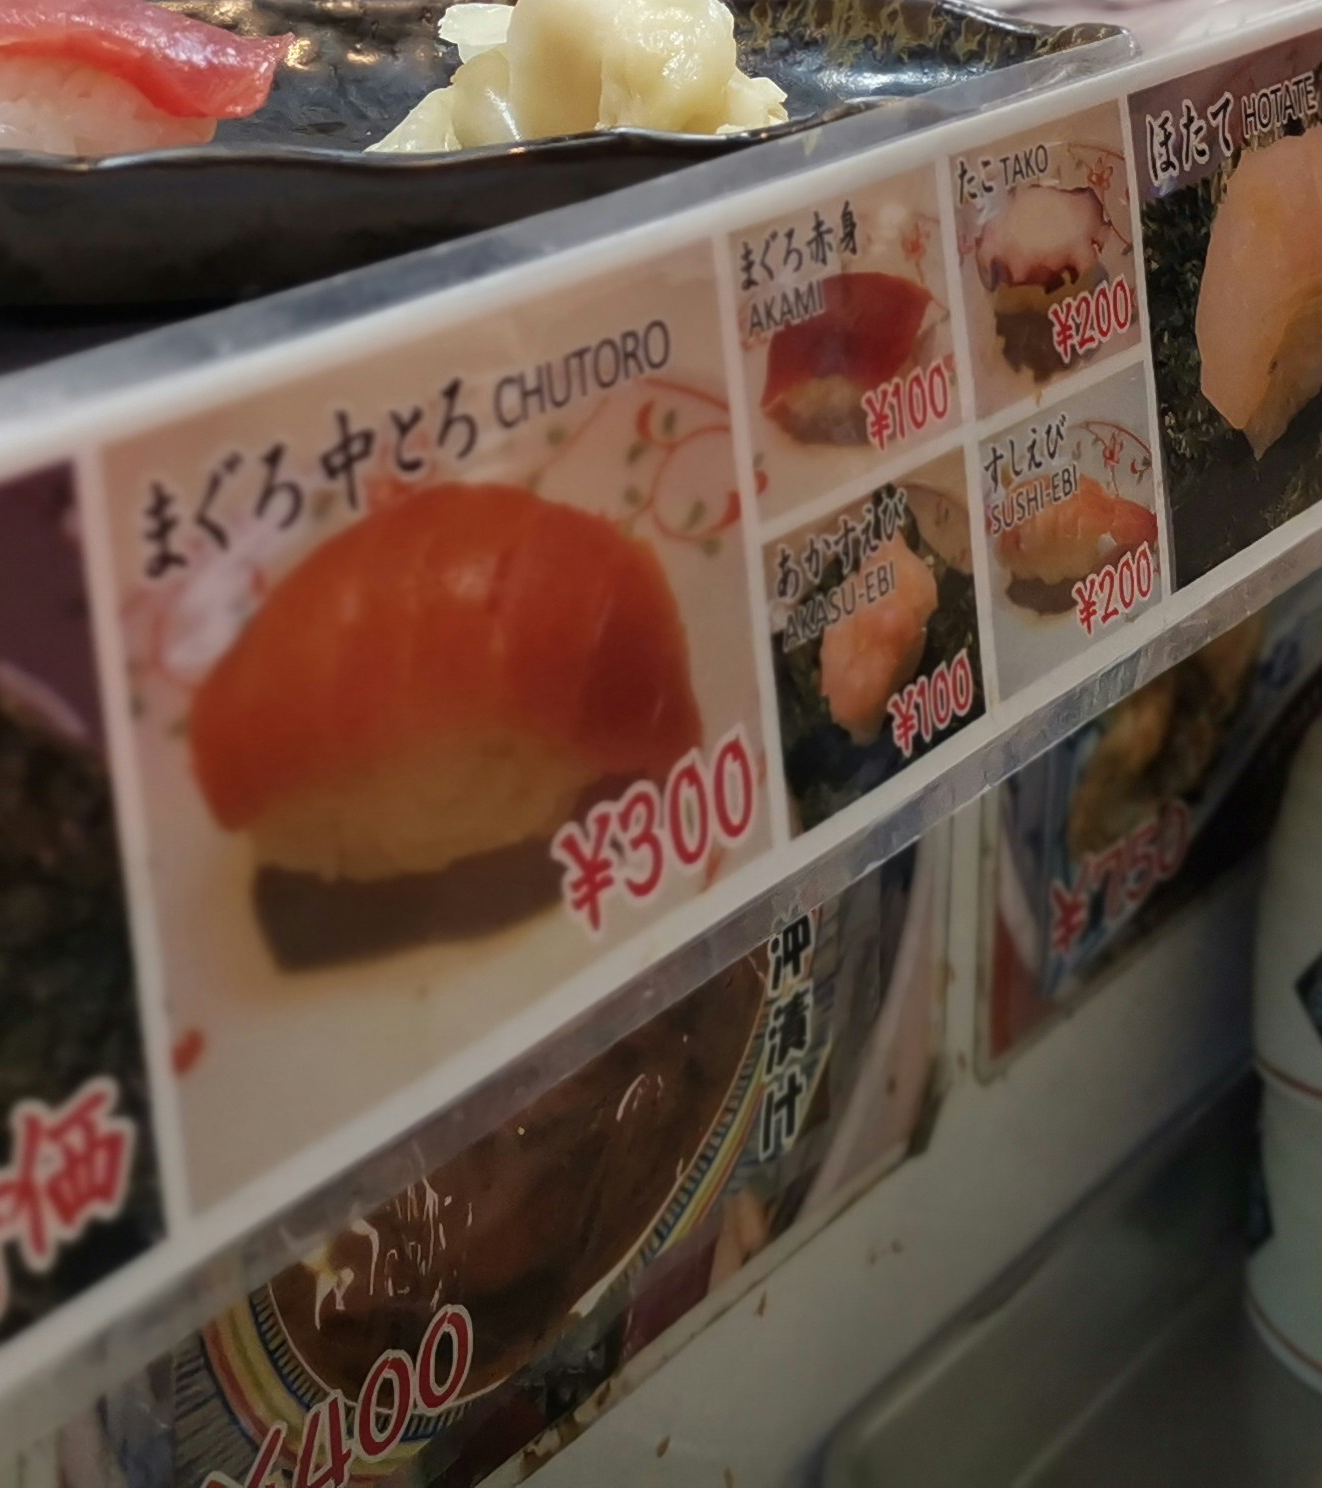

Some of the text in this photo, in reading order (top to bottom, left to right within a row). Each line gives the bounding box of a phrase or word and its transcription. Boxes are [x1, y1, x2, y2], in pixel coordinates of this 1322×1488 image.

[1145, 73, 1318, 184] ほたて HOTATE
[957, 143, 1049, 206] たこ TAKO
[739, 200, 860, 290] まぐろ赤身
[747, 279, 826, 338] AKAMI
[1049, 278, 1131, 362] ¥200
[139, 318, 672, 580] まぐろ中とろ CHUTORO
[863, 362, 949, 450] ¥100
[983, 414, 1069, 494] すしえび
[775, 487, 907, 600] あかすえび
[990, 464, 1079, 535] SUSHI-EBI
[783, 559, 896, 650] AKASU-EBI
[1073, 545, 1152, 635] ¥200
[888, 653, 974, 756] ¥100
[554, 730, 756, 931] ¥300
[1049, 796, 1193, 956] ¥750
